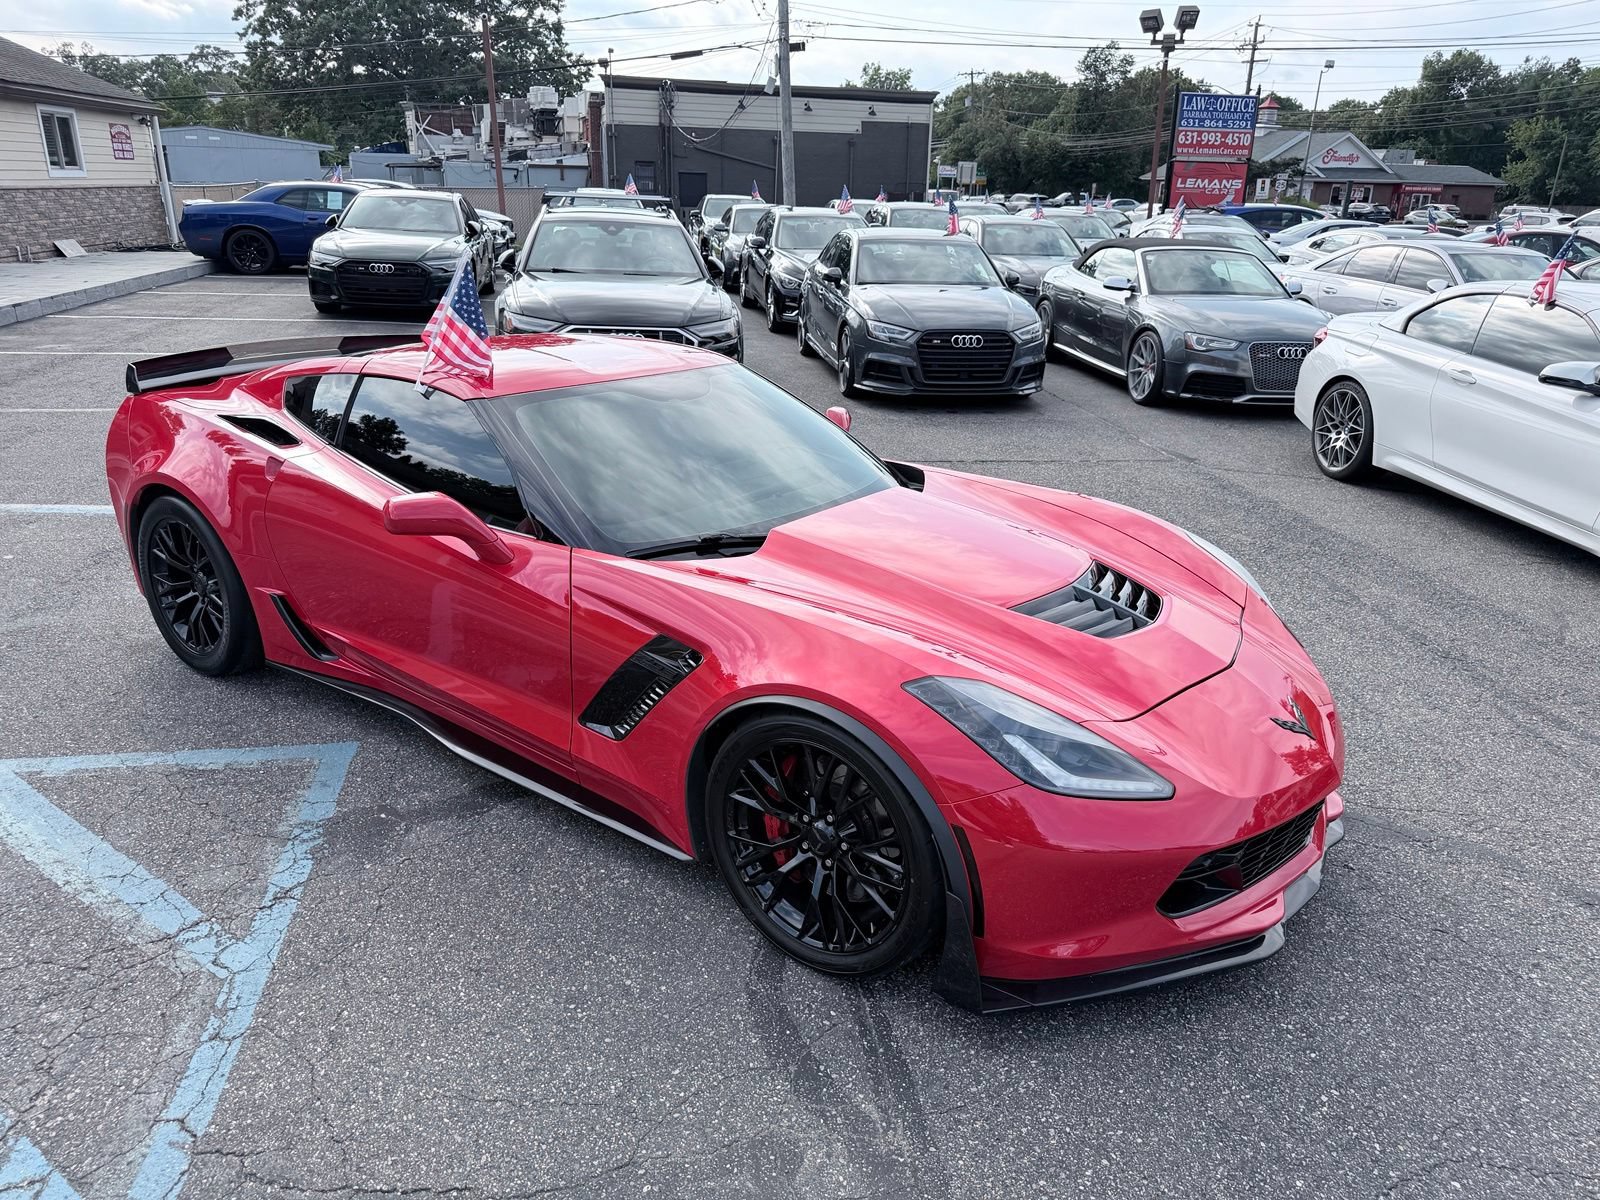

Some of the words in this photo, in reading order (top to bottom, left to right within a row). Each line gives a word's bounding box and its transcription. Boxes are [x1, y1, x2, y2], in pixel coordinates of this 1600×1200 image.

[1182, 96, 1208, 110] LAW
[1217, 97, 1255, 112] OFFICE
[1181, 119, 1251, 128] 631-864-5291
[1178, 132, 1251, 145] 631-993-4510
[1177, 147, 1249, 155] www.LemansCars.com
[1176, 178, 1242, 189] LEMANS
